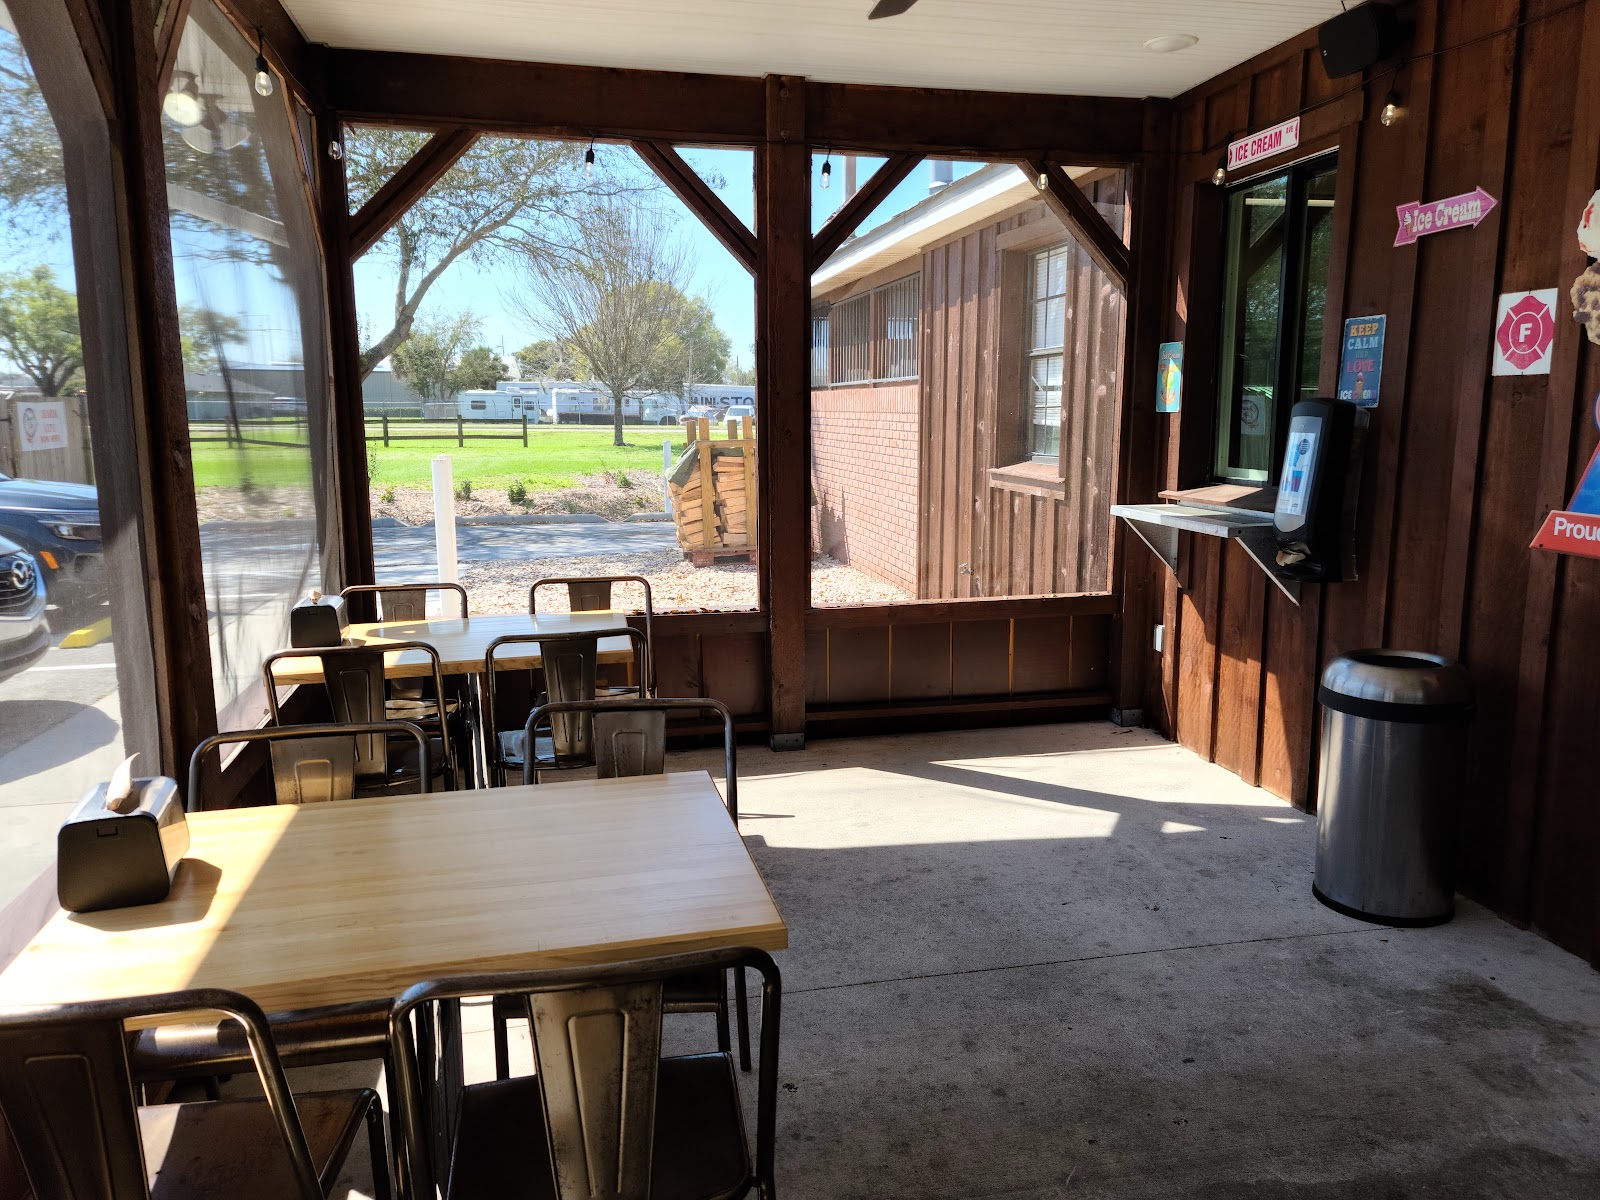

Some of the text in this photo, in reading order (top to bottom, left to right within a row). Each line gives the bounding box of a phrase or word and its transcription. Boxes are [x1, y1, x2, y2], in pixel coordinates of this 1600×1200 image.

[1235, 143, 1248, 162] ICE
[1251, 130, 1282, 156] CREAM
[1412, 198, 1481, 233] Ice Cream
[1350, 323, 1378, 337] KEEP
[1518, 322, 1533, 343] F
[1347, 336, 1379, 350] CALM
[1346, 359, 1375, 372] LOVE
[1339, 389, 1353, 400] ICE
